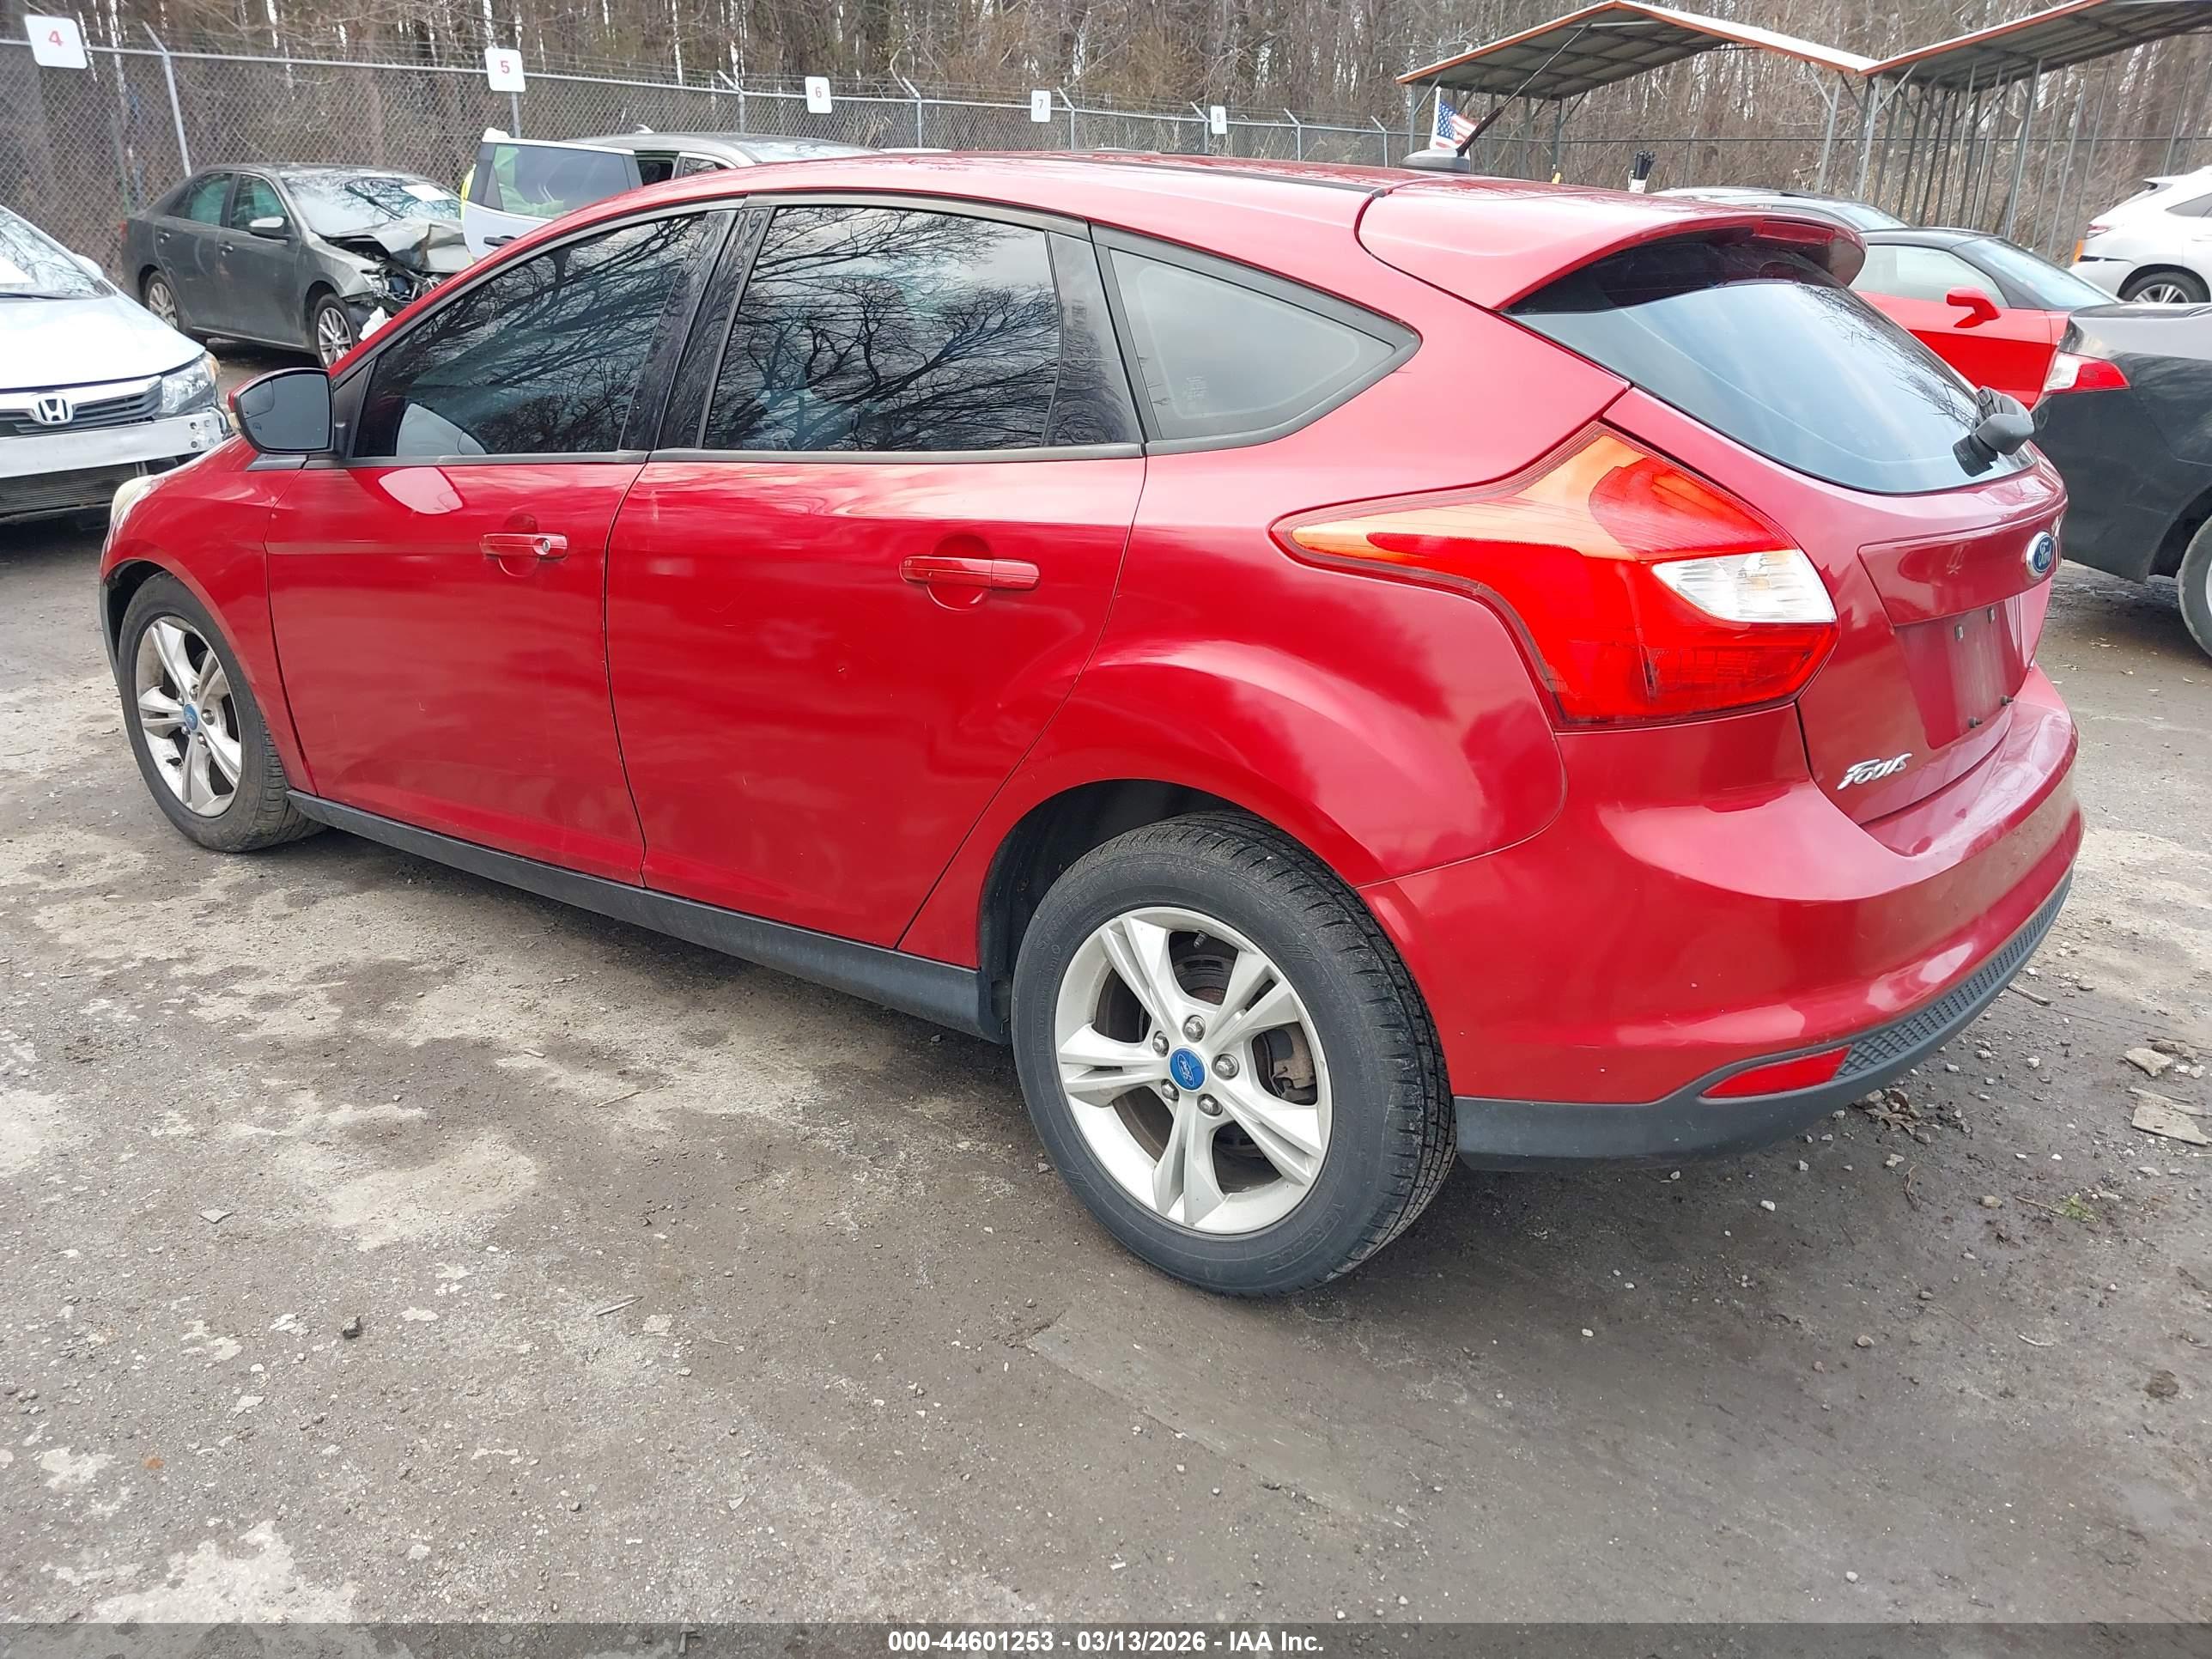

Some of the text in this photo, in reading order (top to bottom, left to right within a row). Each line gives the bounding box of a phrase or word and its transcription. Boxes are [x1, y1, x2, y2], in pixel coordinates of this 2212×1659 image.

[48, 30, 64, 46] 4
[500, 60, 510, 74] 5
[815, 86, 822, 98] 6
[1038, 99, 1044, 110] 7
[1837, 752, 1913, 790] Focus
